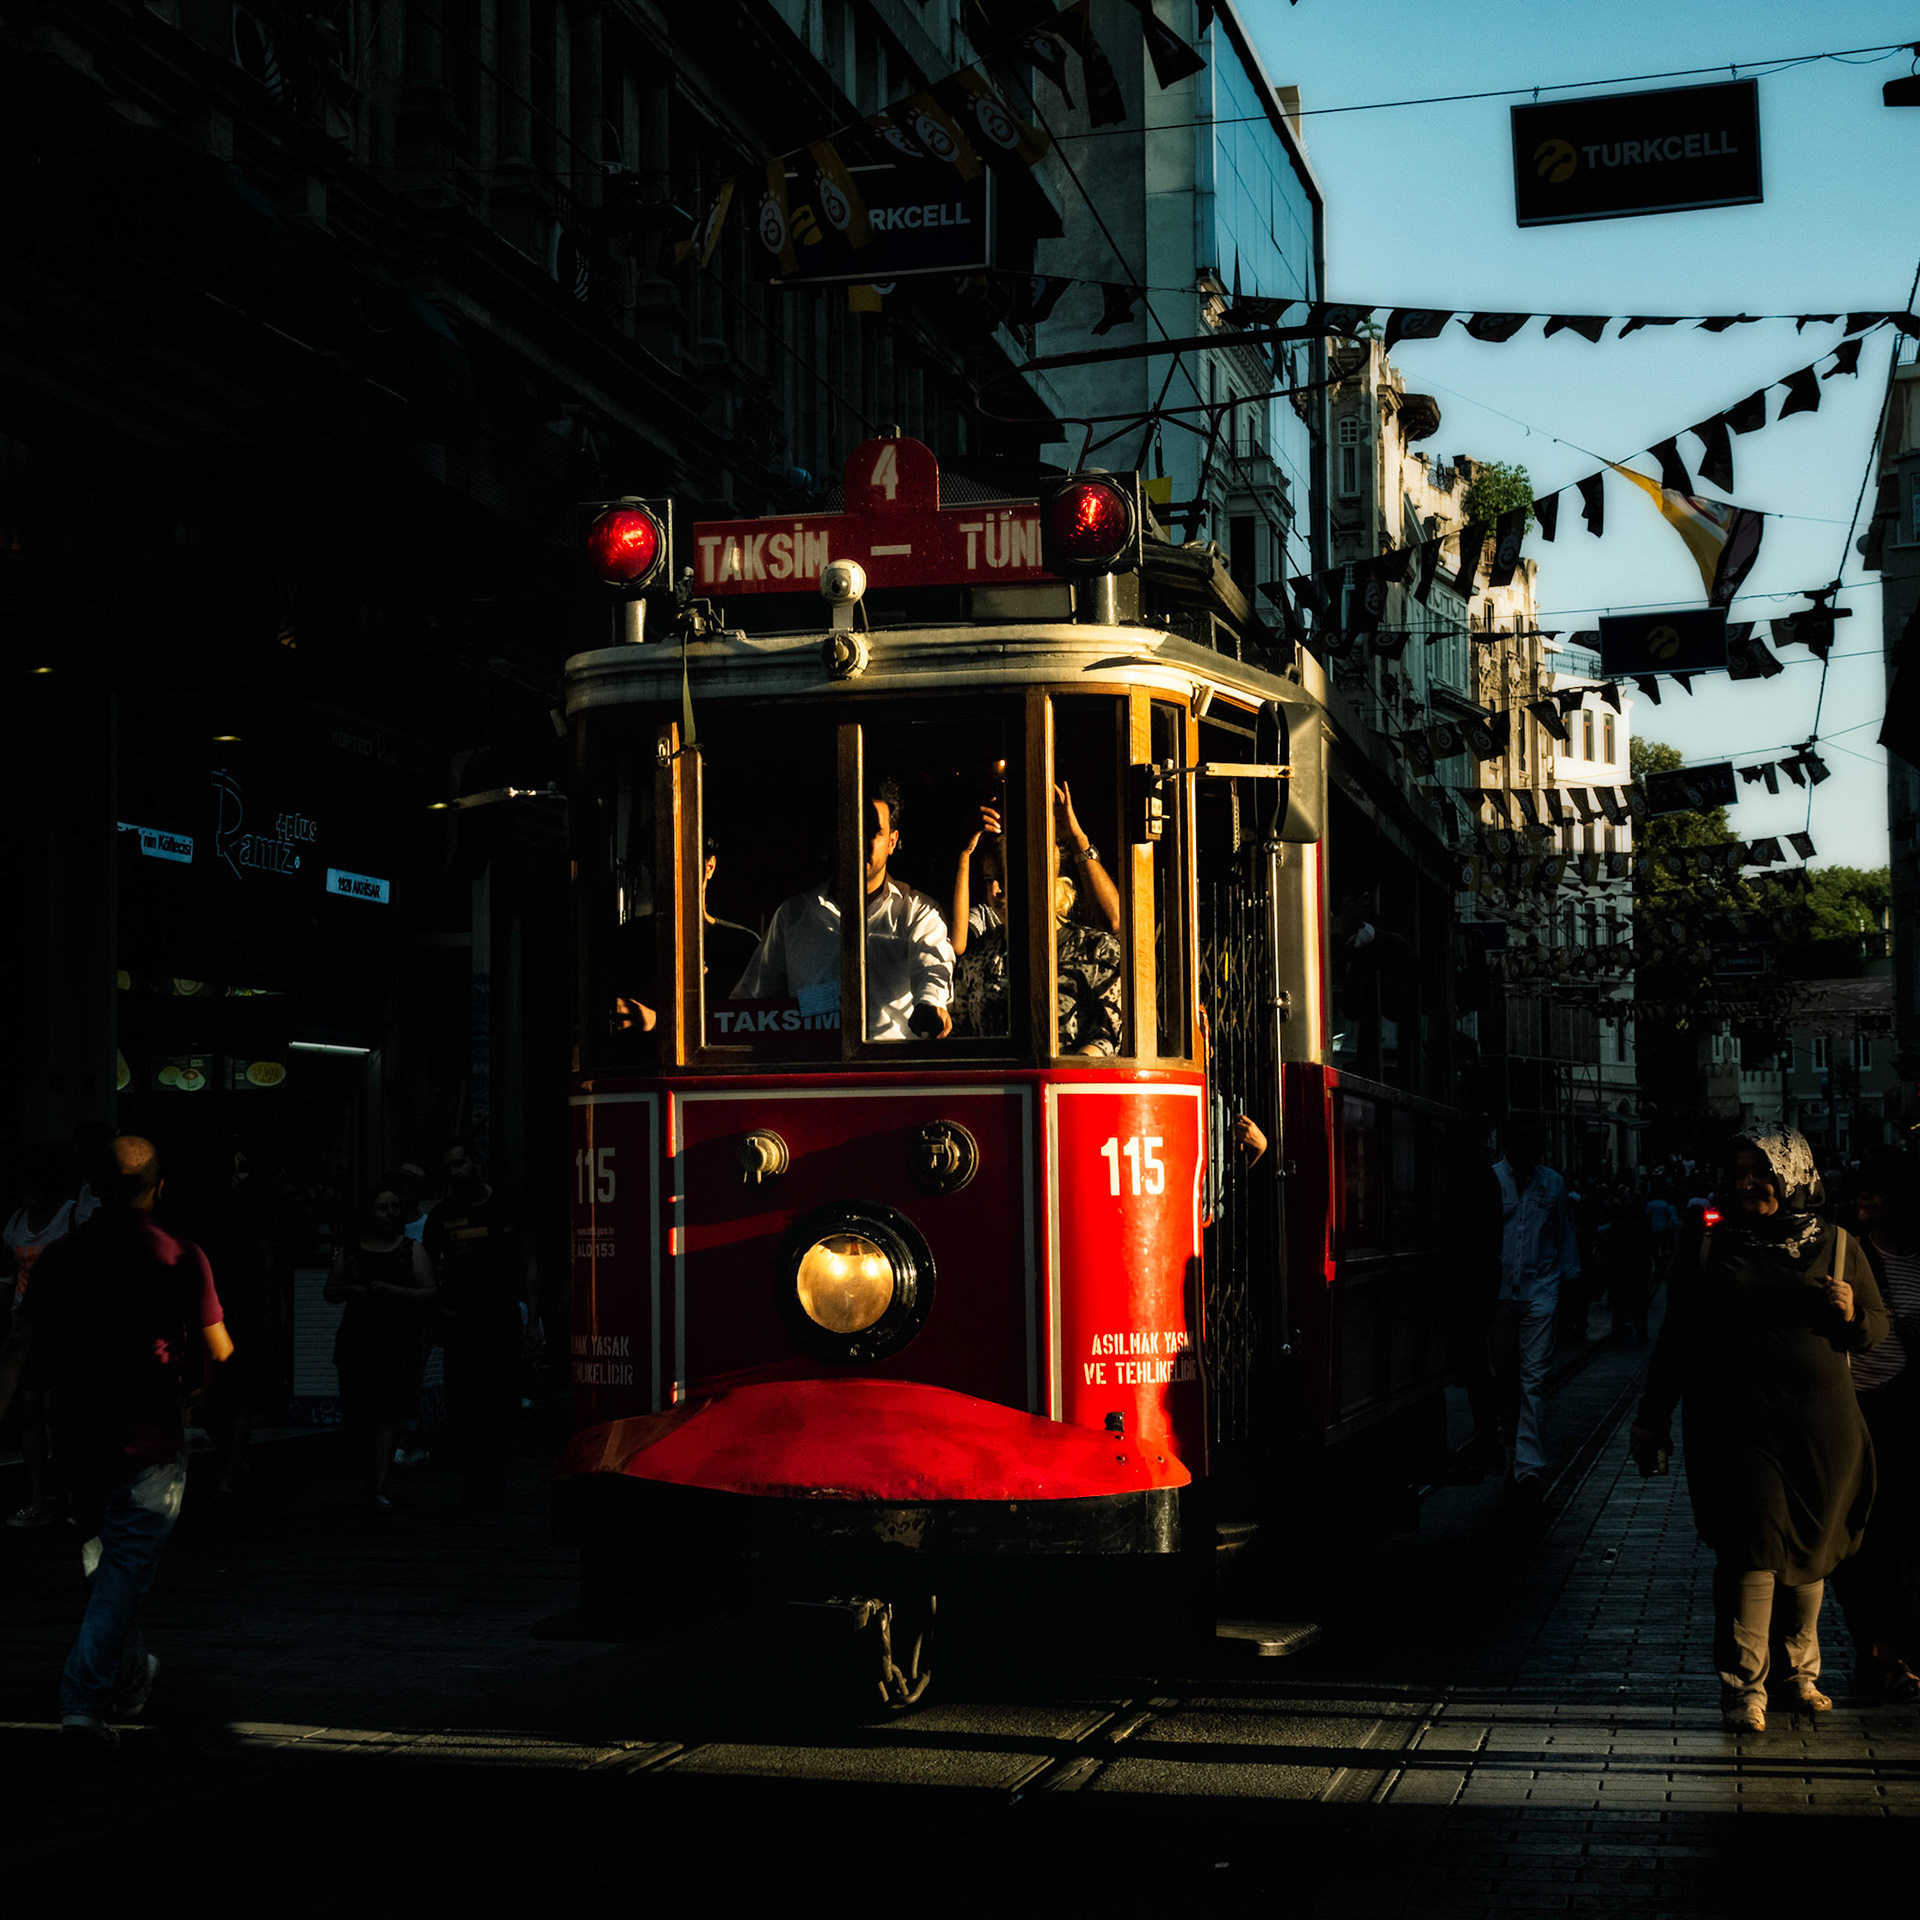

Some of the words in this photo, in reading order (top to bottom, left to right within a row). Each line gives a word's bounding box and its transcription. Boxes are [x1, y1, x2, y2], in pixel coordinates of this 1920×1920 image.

[1581, 130, 1739, 170] TURKCELL
[868, 202, 971, 231] RKCELL
[870, 443, 900, 501] 4
[697, 522, 829, 583] TAKSİM
[959, 511, 1043, 570] TÜN
[575, 1146, 616, 1204] 115
[1100, 1136, 1166, 1197] 115
[595, 1242, 616, 1259] 153
[591, 1335, 630, 1357] YASAK
[1090, 1332, 1159, 1355] ASILMAK
[1083, 1361, 1107, 1386] VE
